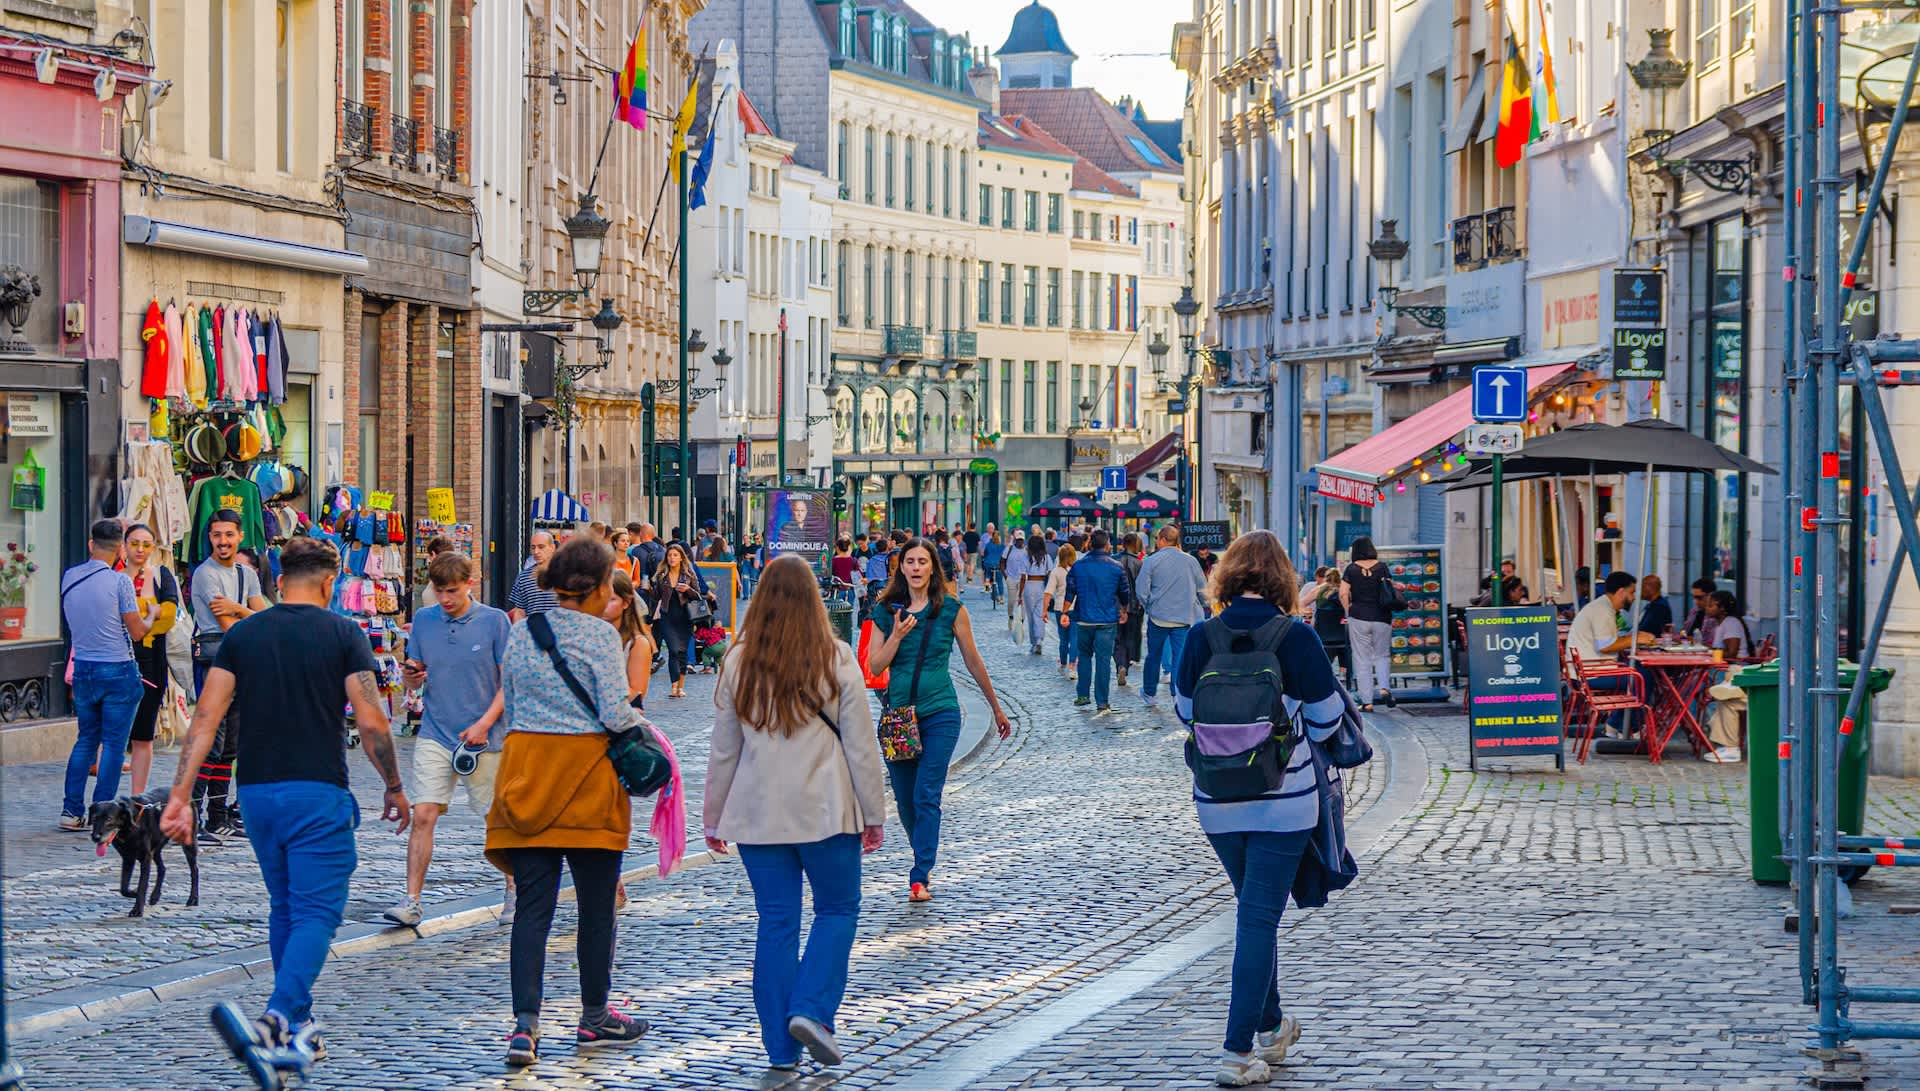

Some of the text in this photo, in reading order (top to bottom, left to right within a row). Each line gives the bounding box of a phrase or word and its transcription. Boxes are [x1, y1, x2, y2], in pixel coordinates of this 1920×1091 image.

[1616, 330, 1664, 350] Lloyd
[1184, 525, 1220, 533] TERRASSE
[1184, 535, 1224, 544] OUVERTE
[768, 541, 829, 551] DOMINIQUE A
[1516, 616, 1528, 624] NO
[1529, 615, 1551, 624] PARTY
[1486, 631, 1540, 654] Lloyd
[1487, 676, 1541, 685] Coffee Eatery
[1519, 692, 1557, 702] COFFEE
[1475, 714, 1558, 726] BRUNCH ALL-DAY
